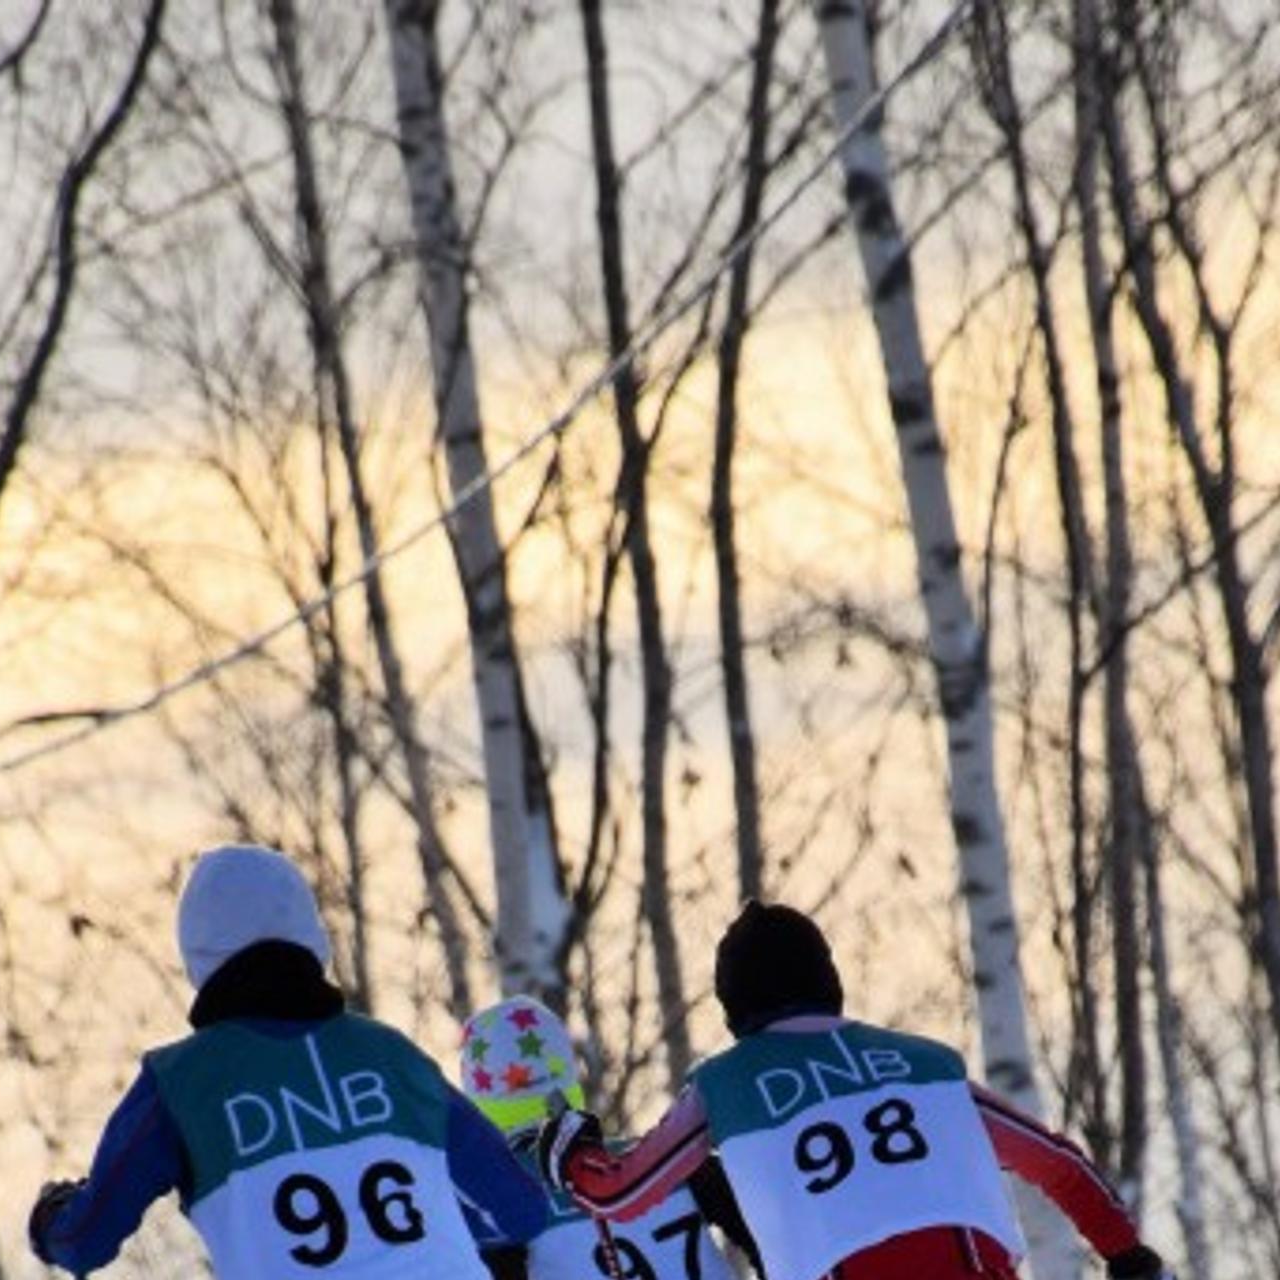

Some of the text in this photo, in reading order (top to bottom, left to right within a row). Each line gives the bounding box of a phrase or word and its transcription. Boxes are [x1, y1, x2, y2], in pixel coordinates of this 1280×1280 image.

[224, 1033, 393, 1156] DNB
[756, 1031, 912, 1118] DNB
[795, 1098, 929, 1194] 98
[272, 1159, 426, 1269] 96
